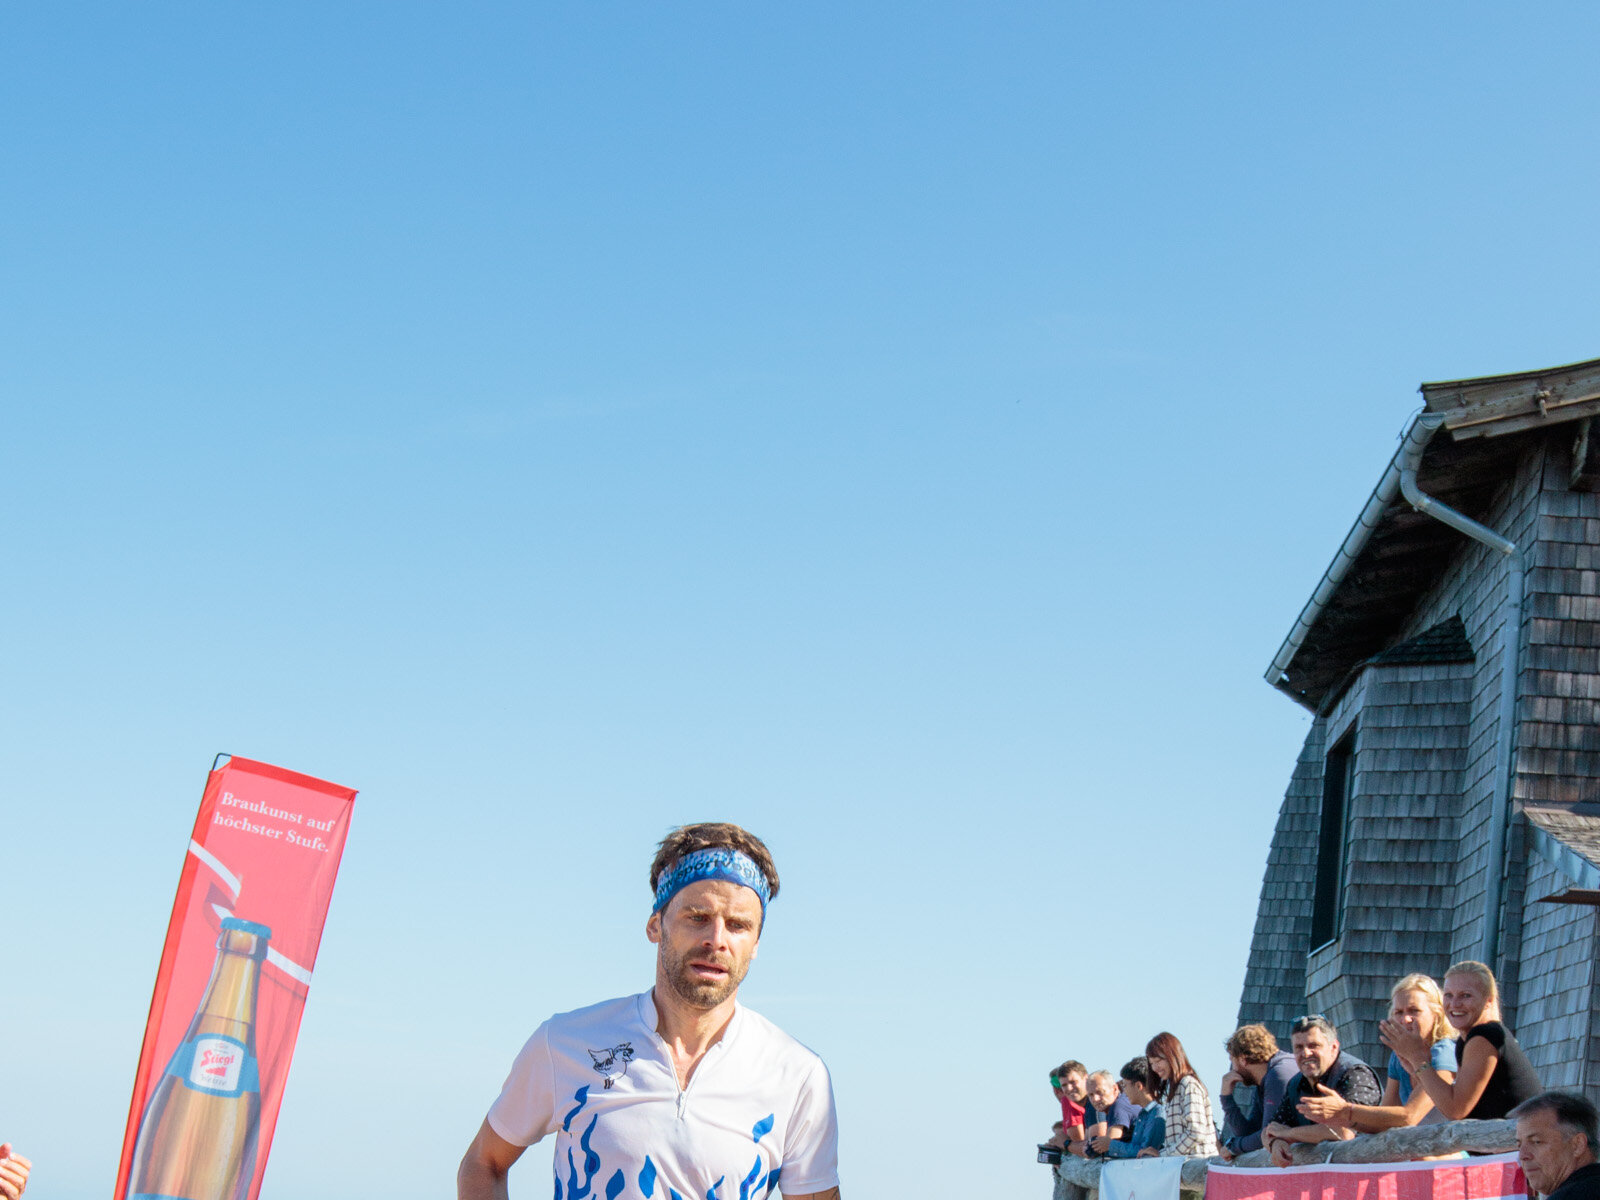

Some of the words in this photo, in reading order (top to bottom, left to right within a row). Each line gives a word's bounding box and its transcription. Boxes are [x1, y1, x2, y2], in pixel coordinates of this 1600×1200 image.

[213, 812, 283, 840] höchster
[285, 829, 329, 853] Stufe.
[221, 792, 303, 825] Braukunst
[306, 818, 335, 833] auf
